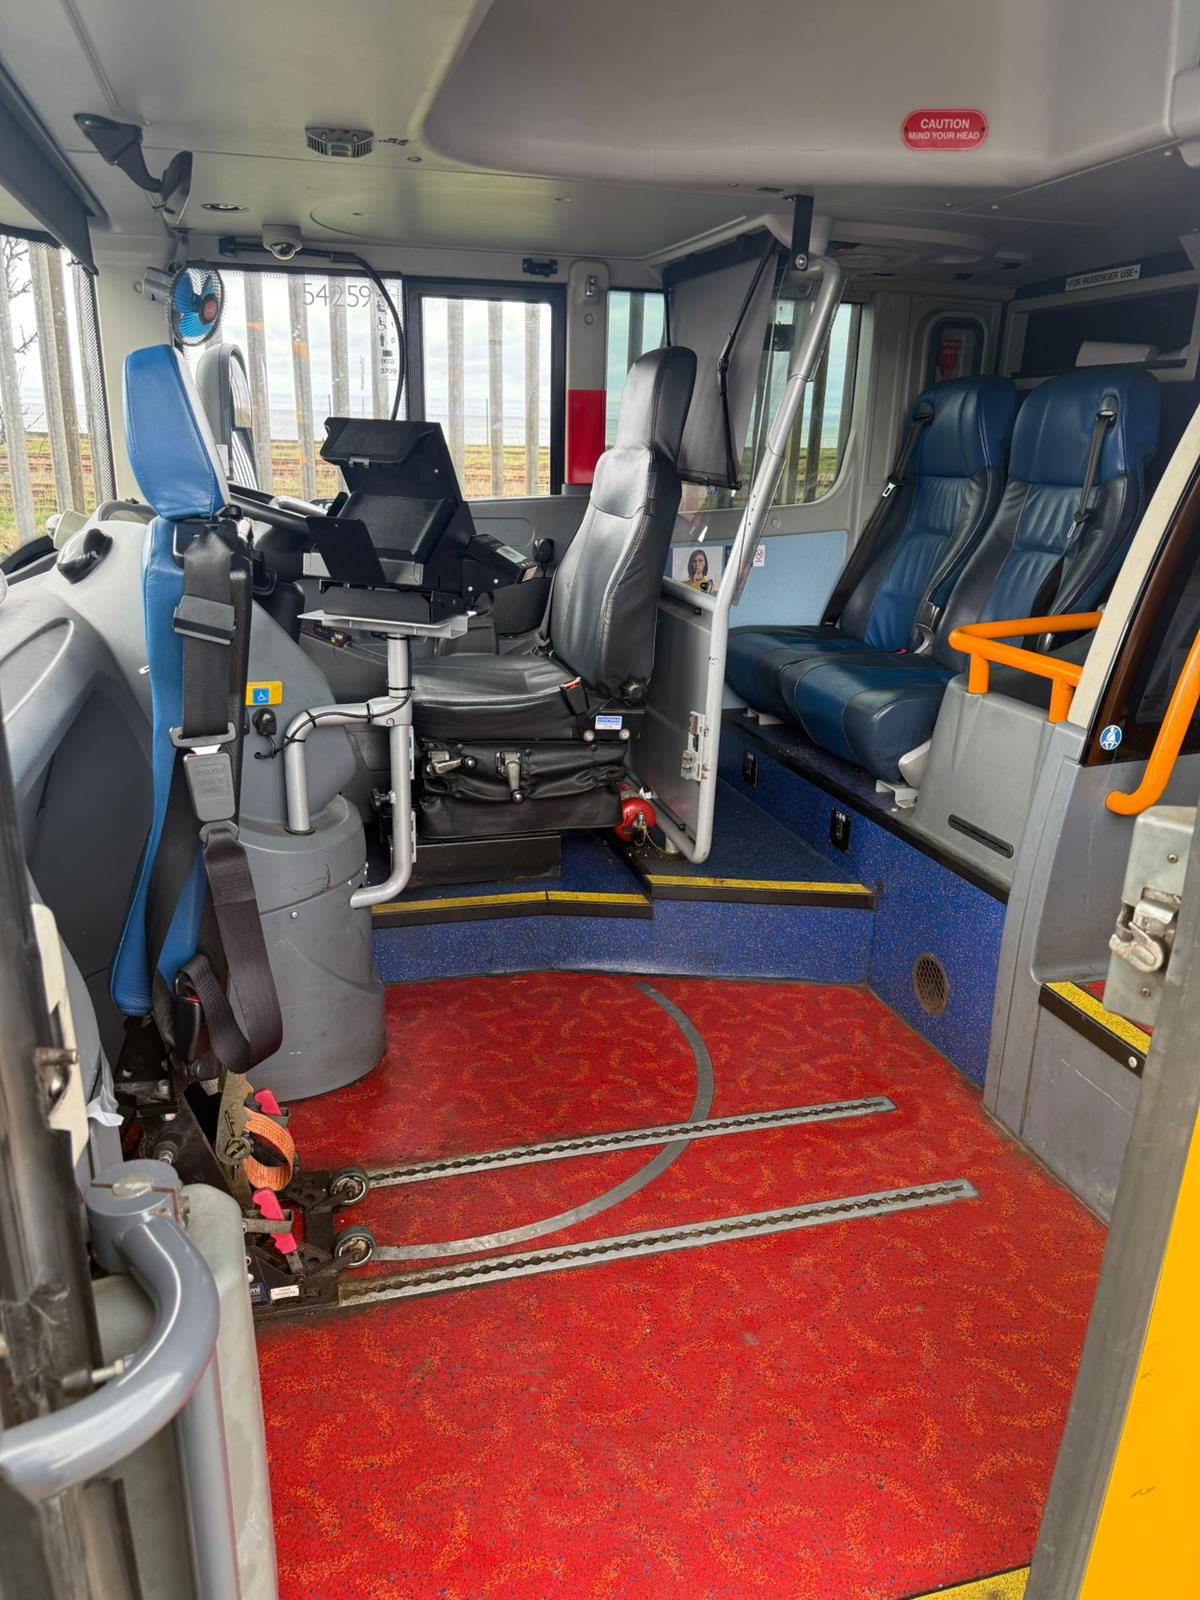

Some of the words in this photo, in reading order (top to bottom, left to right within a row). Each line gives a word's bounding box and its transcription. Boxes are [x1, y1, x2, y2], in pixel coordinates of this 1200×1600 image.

[920, 118, 970, 129] CAUTION
[908, 131, 930, 140] MIND
[932, 131, 955, 140] YOUR
[956, 131, 980, 140] HEAD
[1069, 278, 1081, 288] FOR
[1082, 271, 1119, 285] PASSENGER
[1120, 267, 1135, 279] USE
[303, 282, 372, 308] 54259
